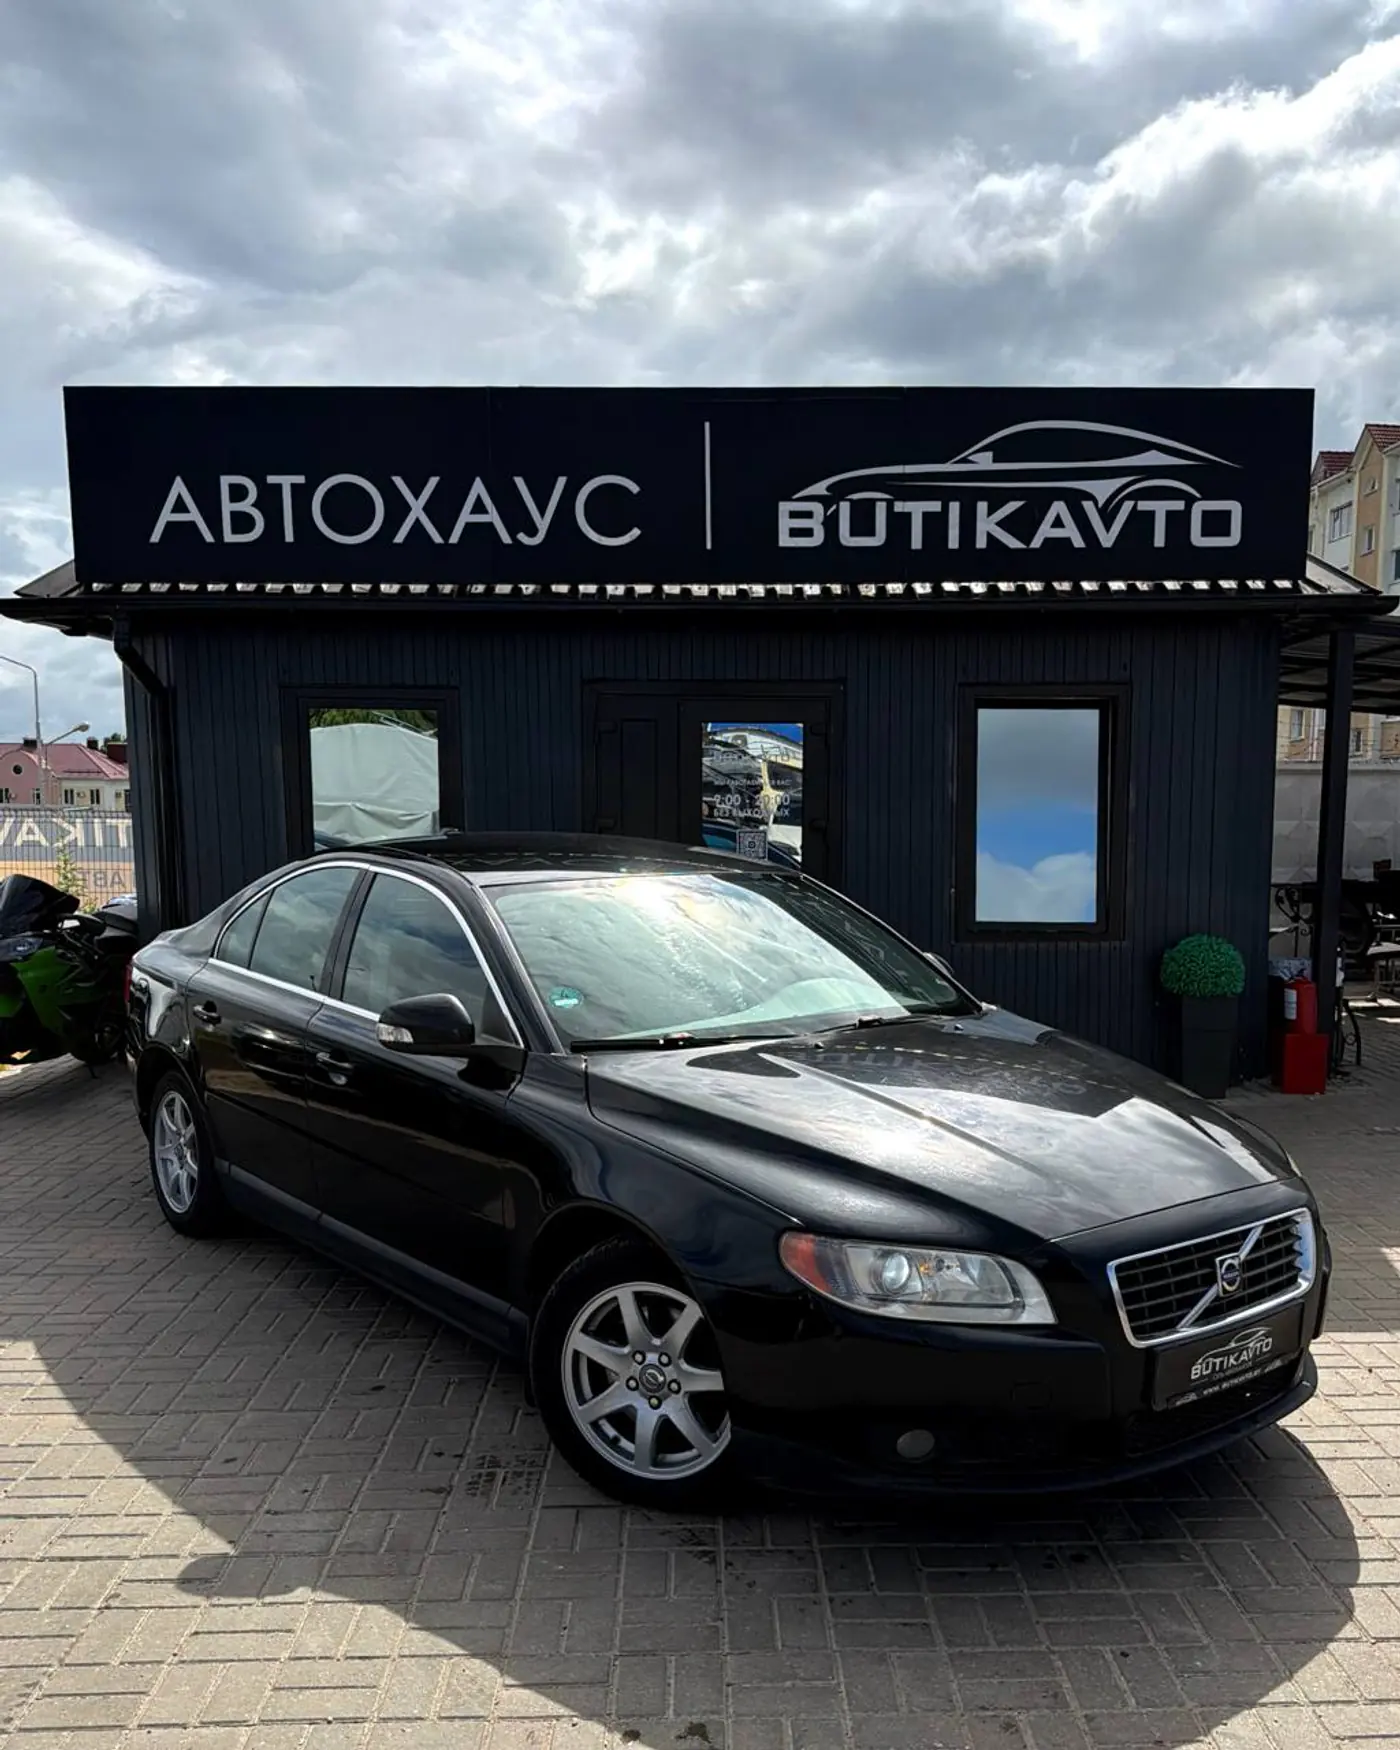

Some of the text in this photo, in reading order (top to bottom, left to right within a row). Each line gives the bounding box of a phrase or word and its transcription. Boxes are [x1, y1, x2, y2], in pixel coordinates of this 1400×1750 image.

[149, 473, 642, 546] АВТОХАУС
[777, 498, 1243, 551] BUTIKAVTO
[713, 794, 741, 806] 9:00
[754, 794, 790, 806] 20:00
[732, 808, 790, 818] ВЫХОЫХ
[1190, 1336, 1273, 1380] BUTIKAVTO
